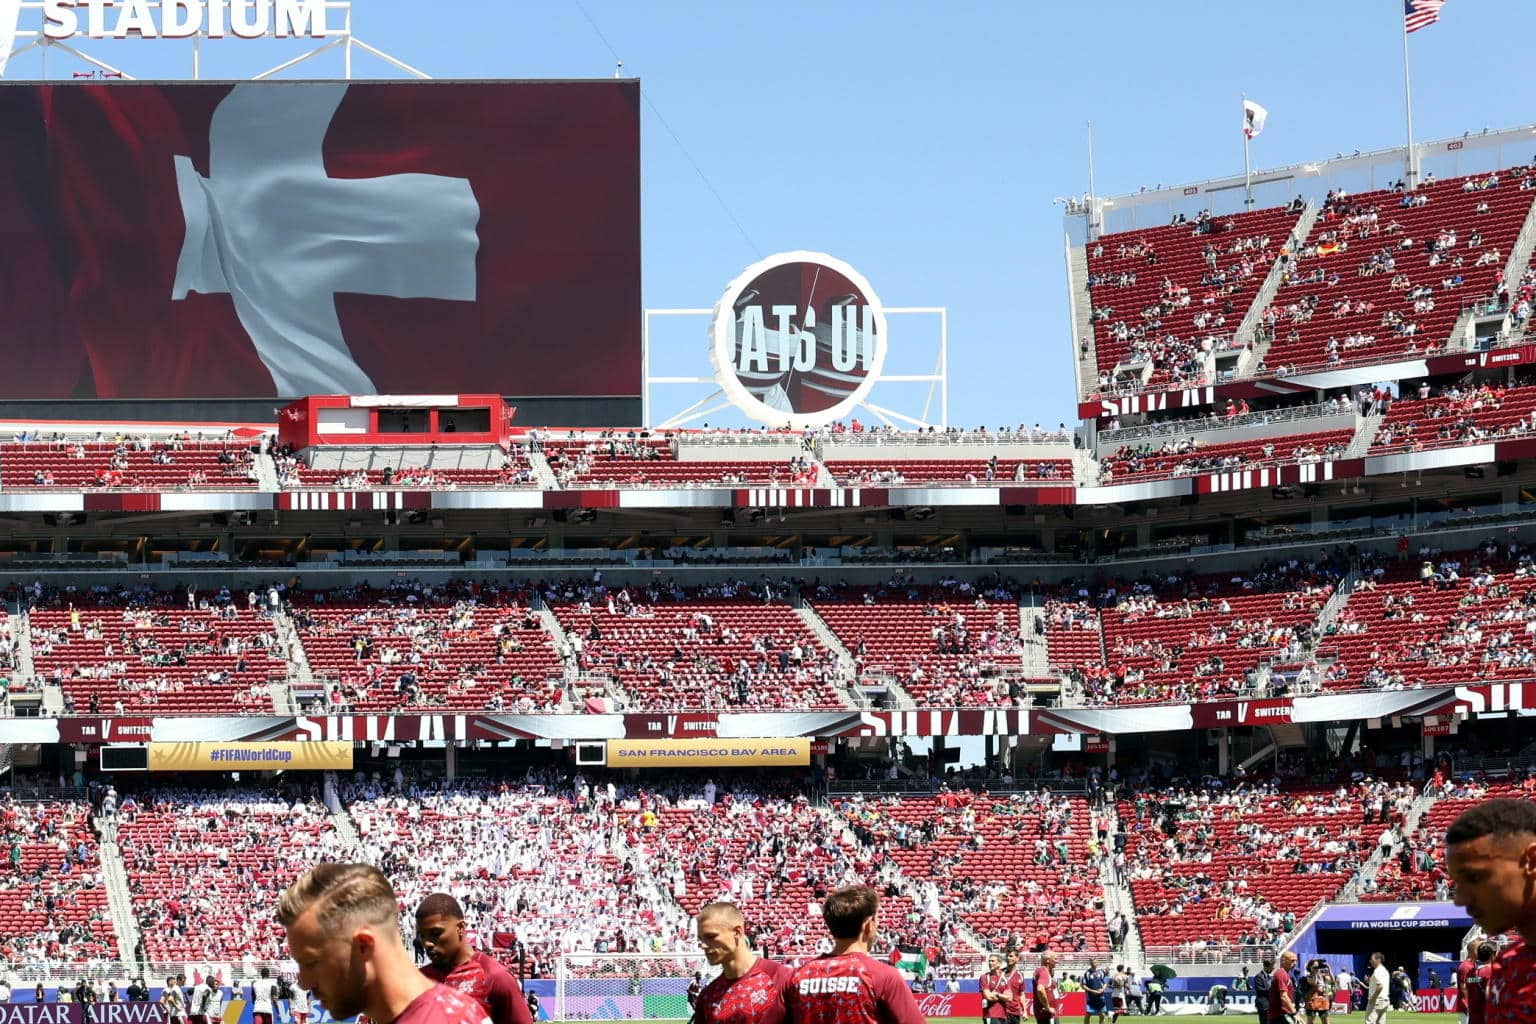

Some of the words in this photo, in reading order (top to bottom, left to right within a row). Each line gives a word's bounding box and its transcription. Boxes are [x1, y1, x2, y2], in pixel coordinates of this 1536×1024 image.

[43, 0, 326, 39] STADIUM
[1480, 353, 1488, 368] V
[1238, 703, 1248, 722] V
[102, 720, 112, 739] V
[668, 715, 677, 735] V
[210, 748, 292, 762] #FIFAWorldCup
[619, 749, 647, 757] SAN
[650, 748, 728, 757] FRANCISCO
[760, 748, 797, 756] AREA
[1351, 921, 1369, 929] FIFA
[1370, 920, 1400, 928] WORLD
[1401, 920, 1418, 928] CUP
[1419, 919, 1449, 927] 2026
[799, 976, 860, 995] SUISSE
[87, 1004, 163, 1024] AIRWA
